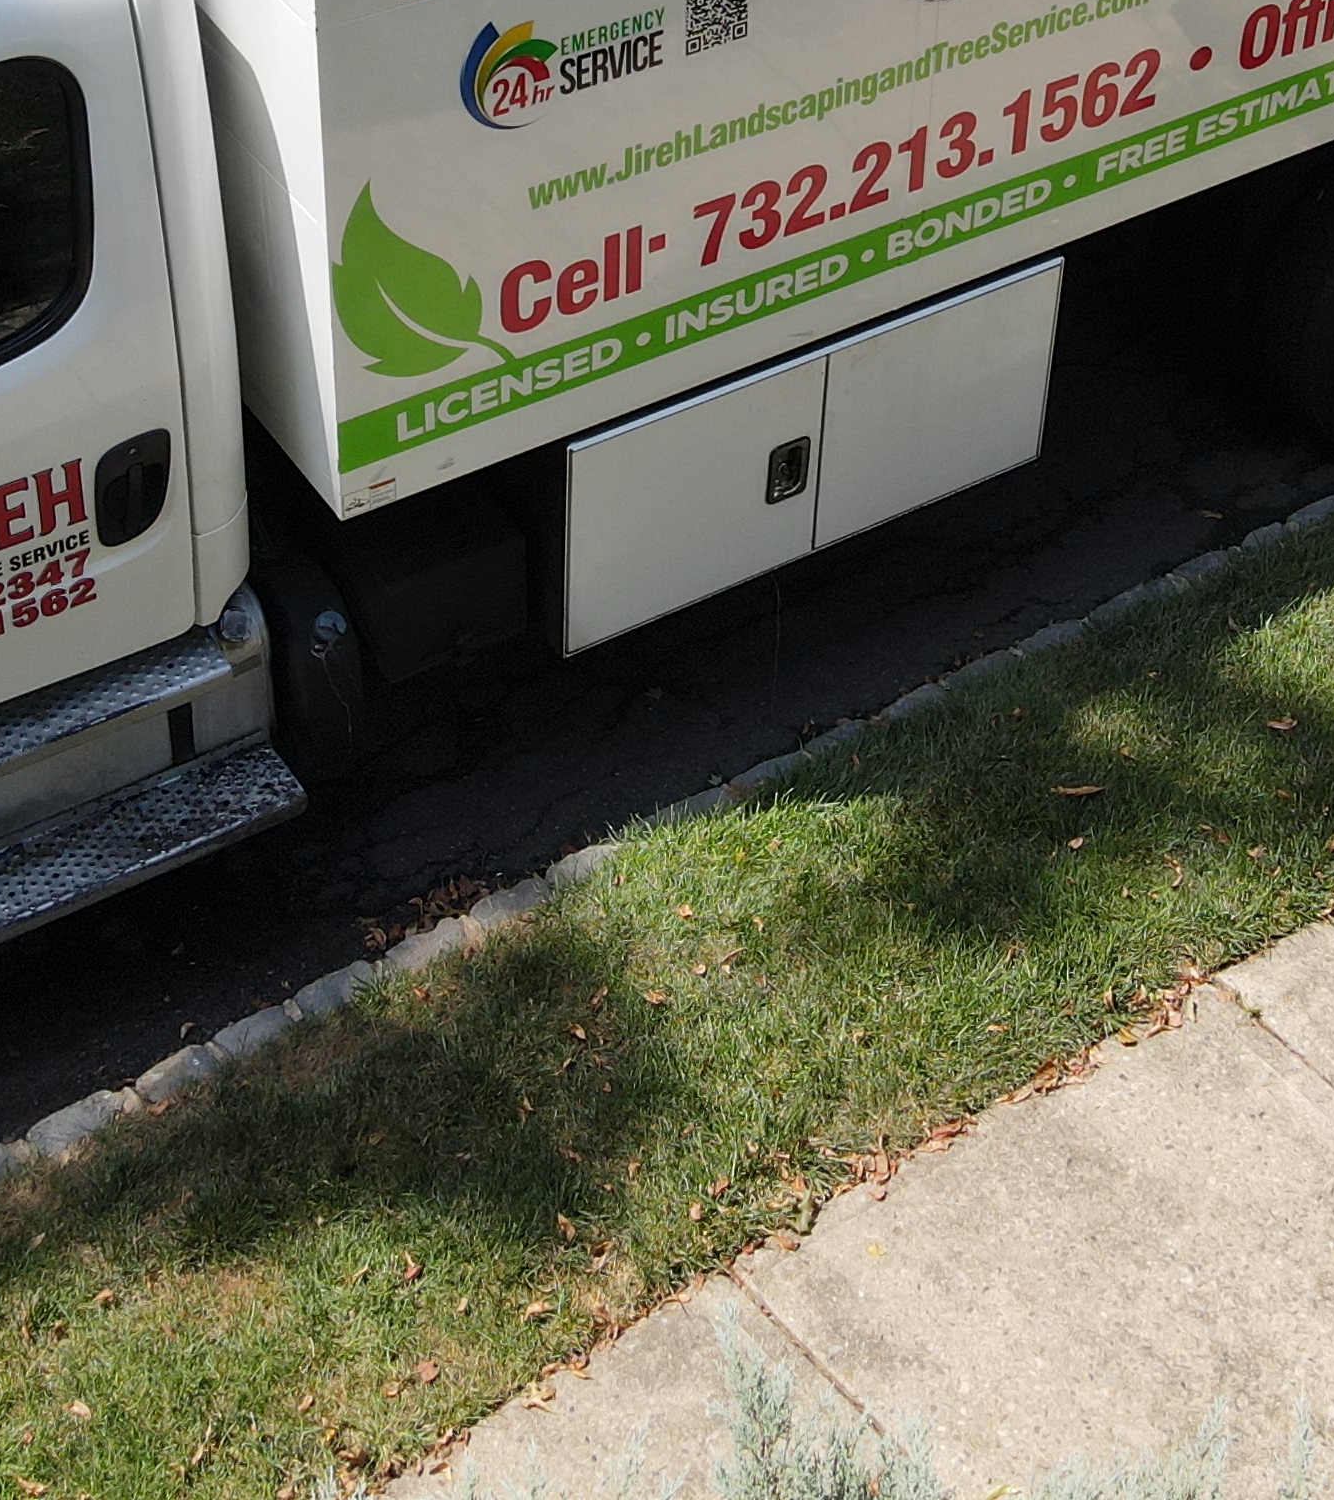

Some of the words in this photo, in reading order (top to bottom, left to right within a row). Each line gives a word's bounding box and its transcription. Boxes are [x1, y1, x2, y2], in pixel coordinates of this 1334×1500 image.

[559, 29, 664, 95] SERVICE
[560, 6, 666, 56] EMERGENCY
[498, 225, 667, 336] Cell-
[692, 47, 1163, 268] 732.213.1562
[395, 336, 622, 443] LICENSED
[664, 252, 849, 345] INSURED
[886, 176, 1053, 263] BONDED
[1095, 127, 1188, 184] FREE
[9, 529, 91, 572] SERVICE
